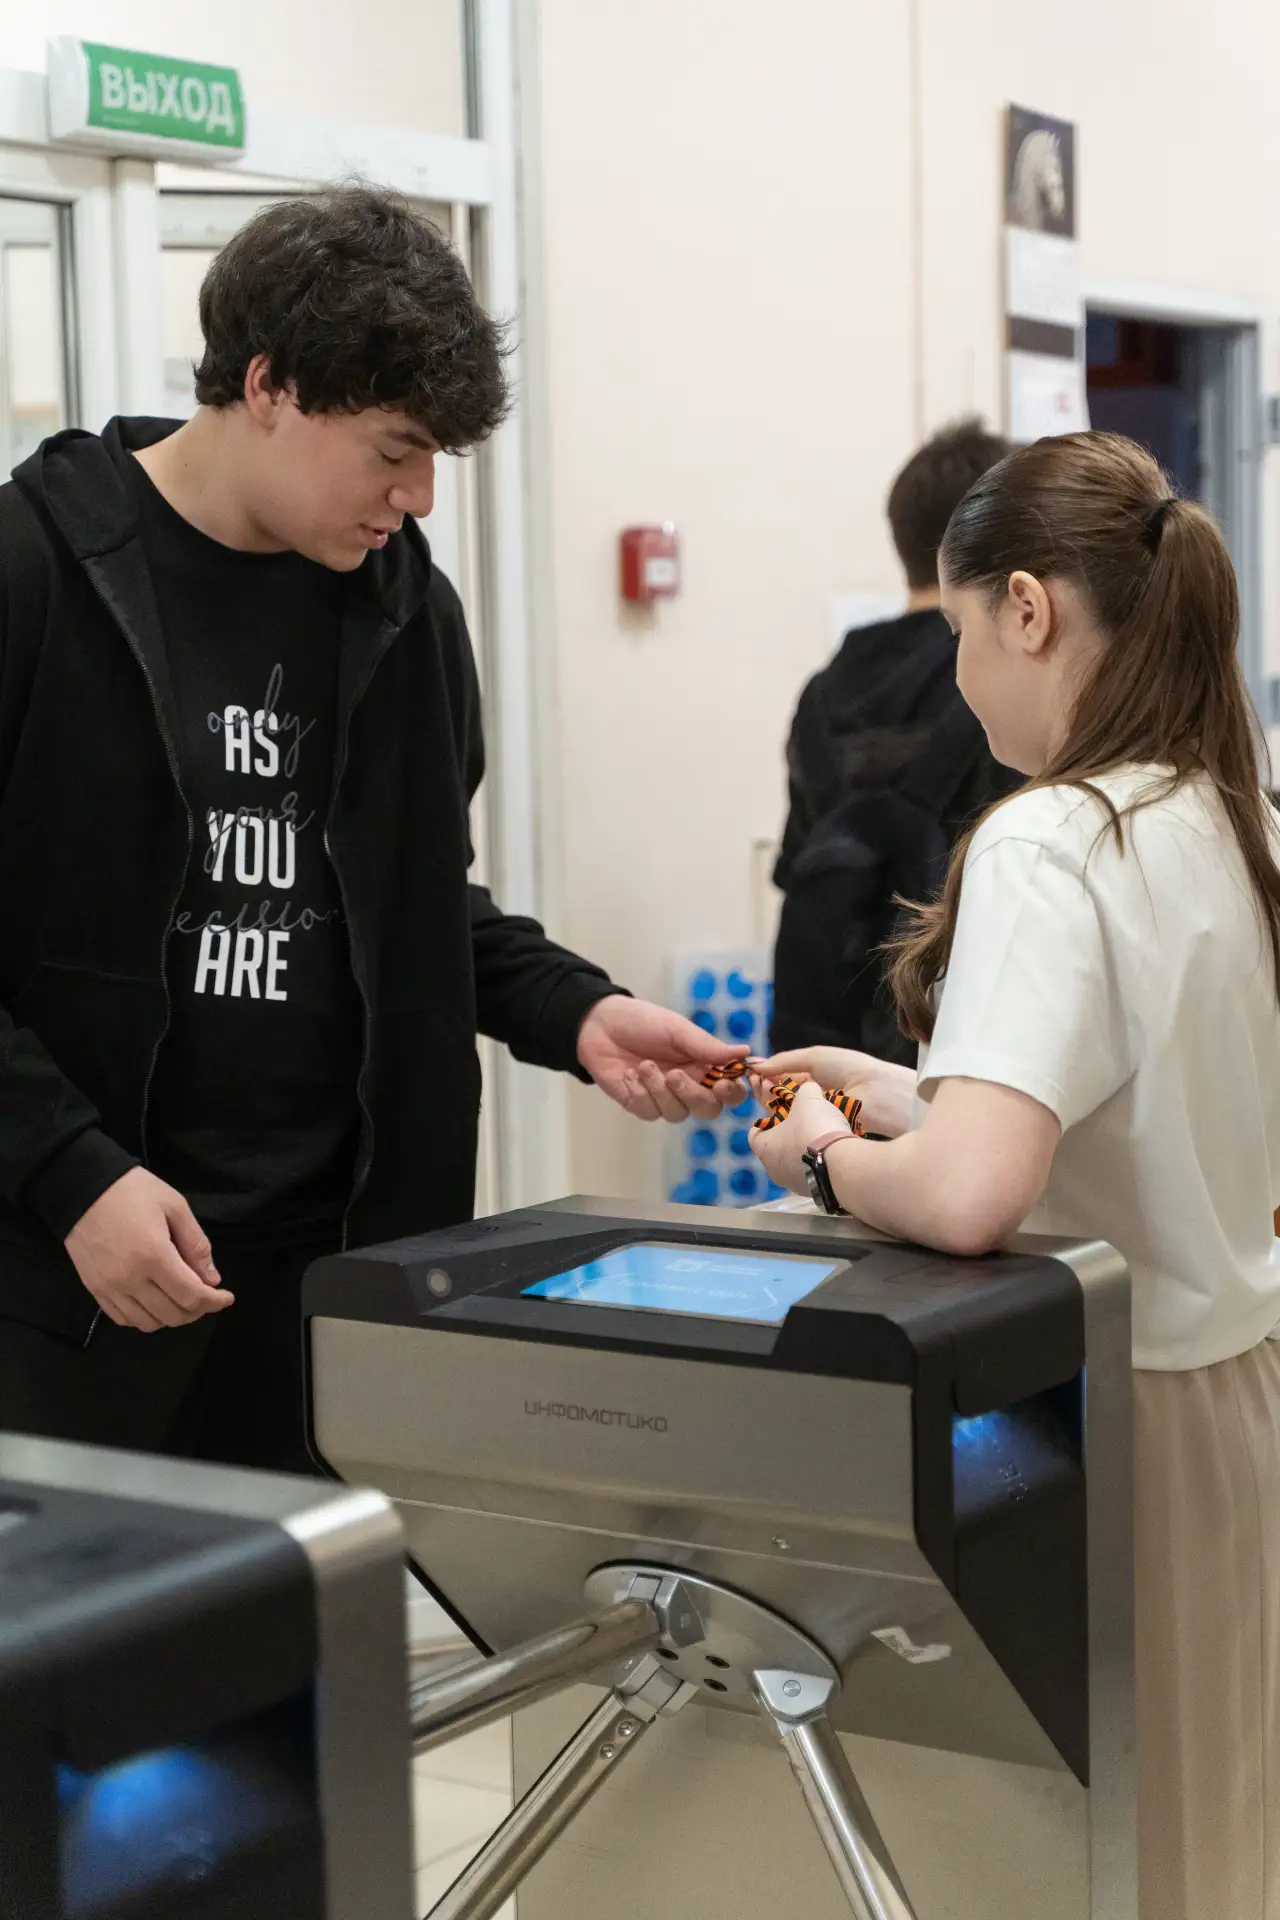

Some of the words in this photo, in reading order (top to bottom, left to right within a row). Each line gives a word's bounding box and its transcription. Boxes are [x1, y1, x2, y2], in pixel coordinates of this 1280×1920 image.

[100, 63, 236, 136] ВЫХОД
[207, 663, 316, 777] only
[223, 703, 280, 778] AS
[207, 810, 296, 890] YOU
[193, 922, 291, 1002] ARE
